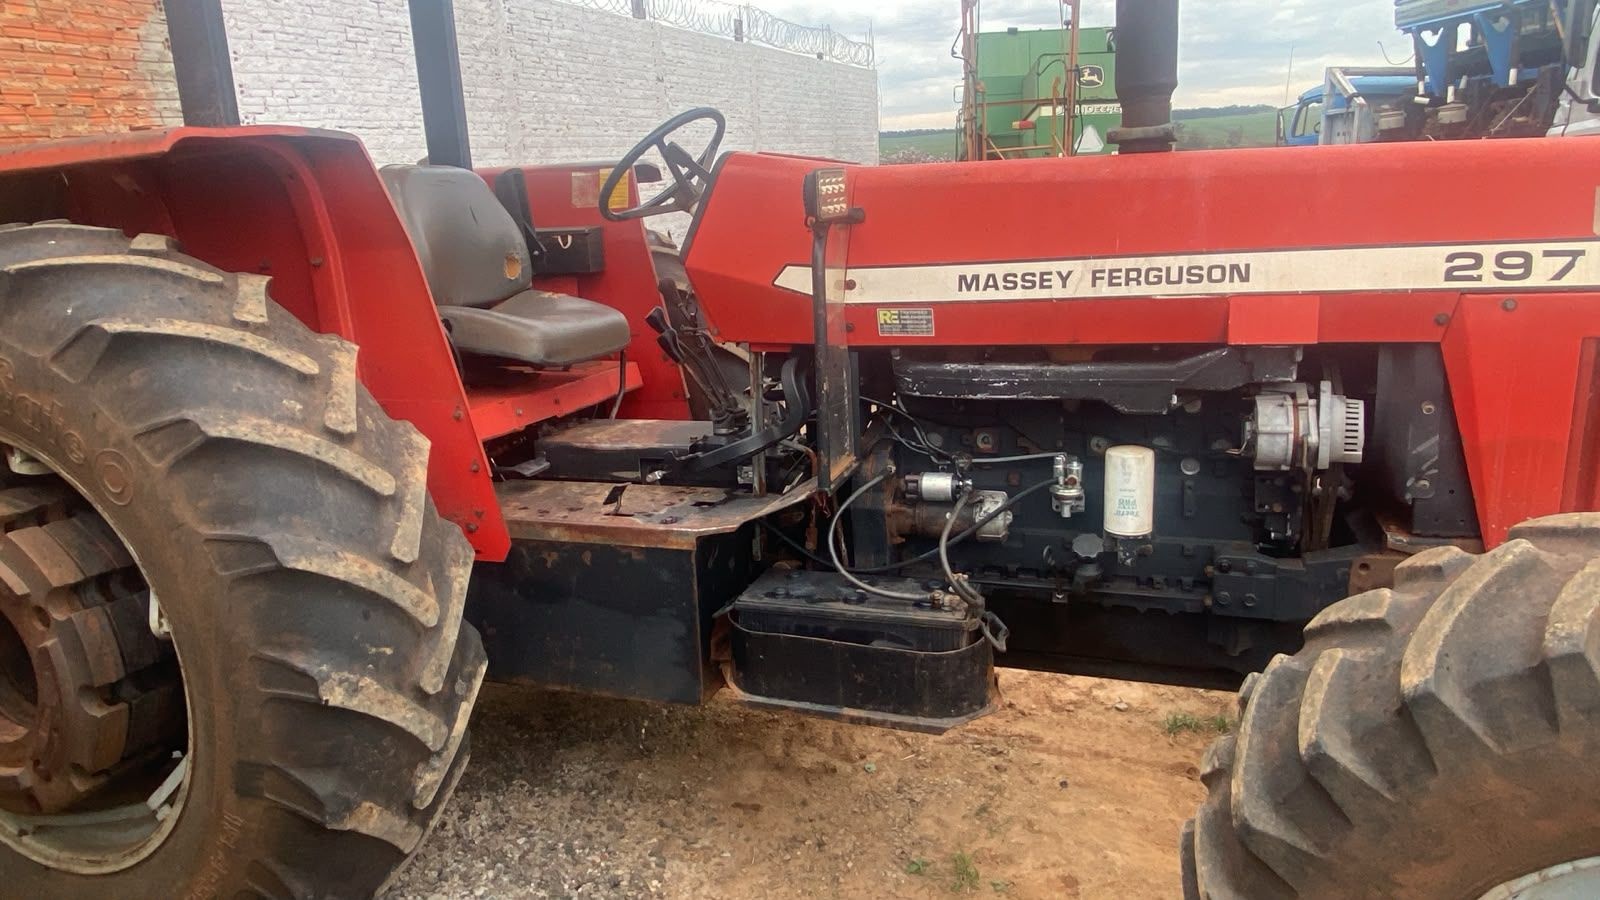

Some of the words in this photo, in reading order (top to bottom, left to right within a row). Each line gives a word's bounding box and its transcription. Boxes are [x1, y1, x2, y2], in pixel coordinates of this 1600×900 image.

[957, 270, 1073, 292] MASSEY
[1091, 263, 1251, 288] FERGUSON
[1443, 249, 1587, 282] 297
[879, 310, 899, 324] RE
